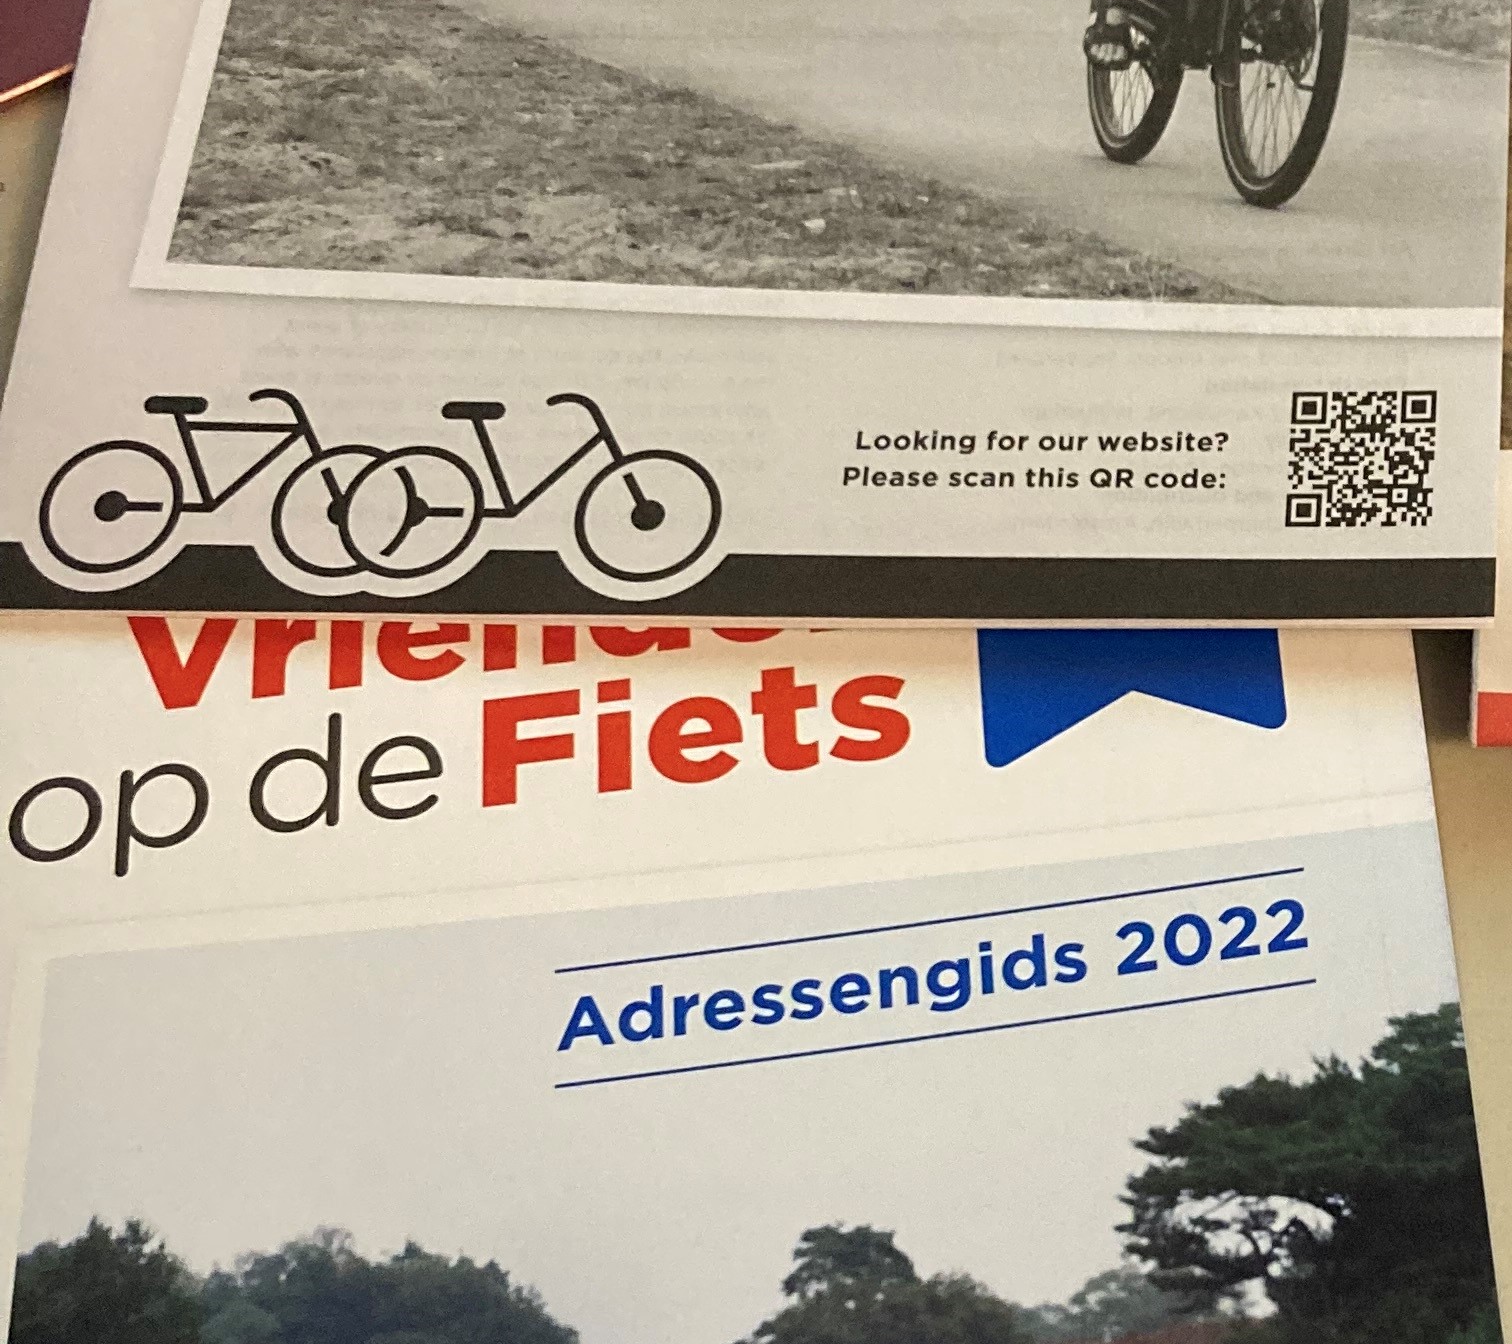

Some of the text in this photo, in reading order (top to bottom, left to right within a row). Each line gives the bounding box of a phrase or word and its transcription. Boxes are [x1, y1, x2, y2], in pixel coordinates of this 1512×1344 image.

[843, 466, 1225, 488] Please scan this QR code:
[856, 431, 1228, 454] Looking for our website?
[9, 667, 909, 877] op de Fiets
[557, 898, 1309, 1051] Adressengids 2022
